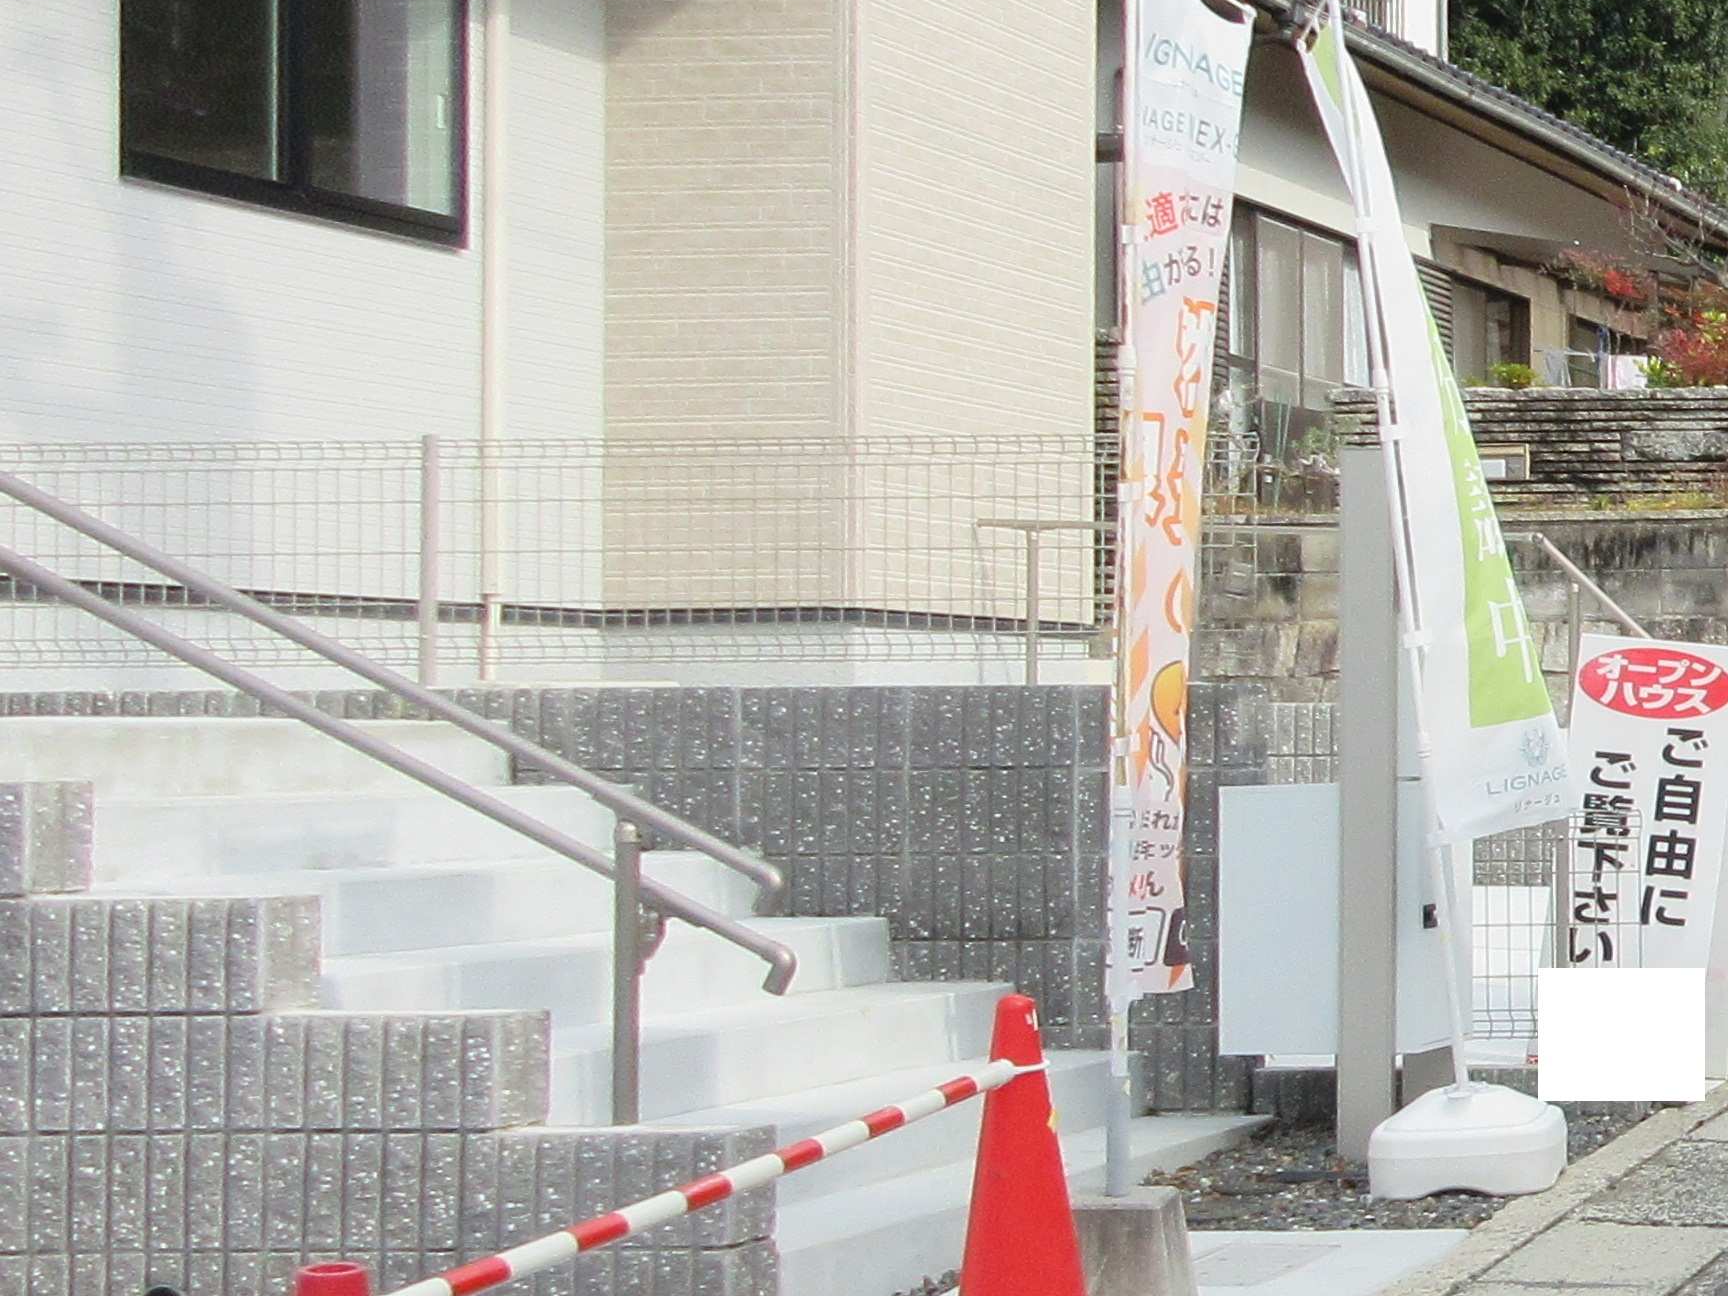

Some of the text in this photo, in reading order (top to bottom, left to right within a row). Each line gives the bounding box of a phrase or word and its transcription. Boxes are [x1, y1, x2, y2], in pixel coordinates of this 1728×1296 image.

[1146, 33, 1243, 97] IGNAGE
[1597, 654, 1722, 686] オープン
[1600, 680, 1711, 714] ハウス
[1568, 750, 1637, 963] ご覧下さい
[1641, 727, 1708, 927] ご自由に
